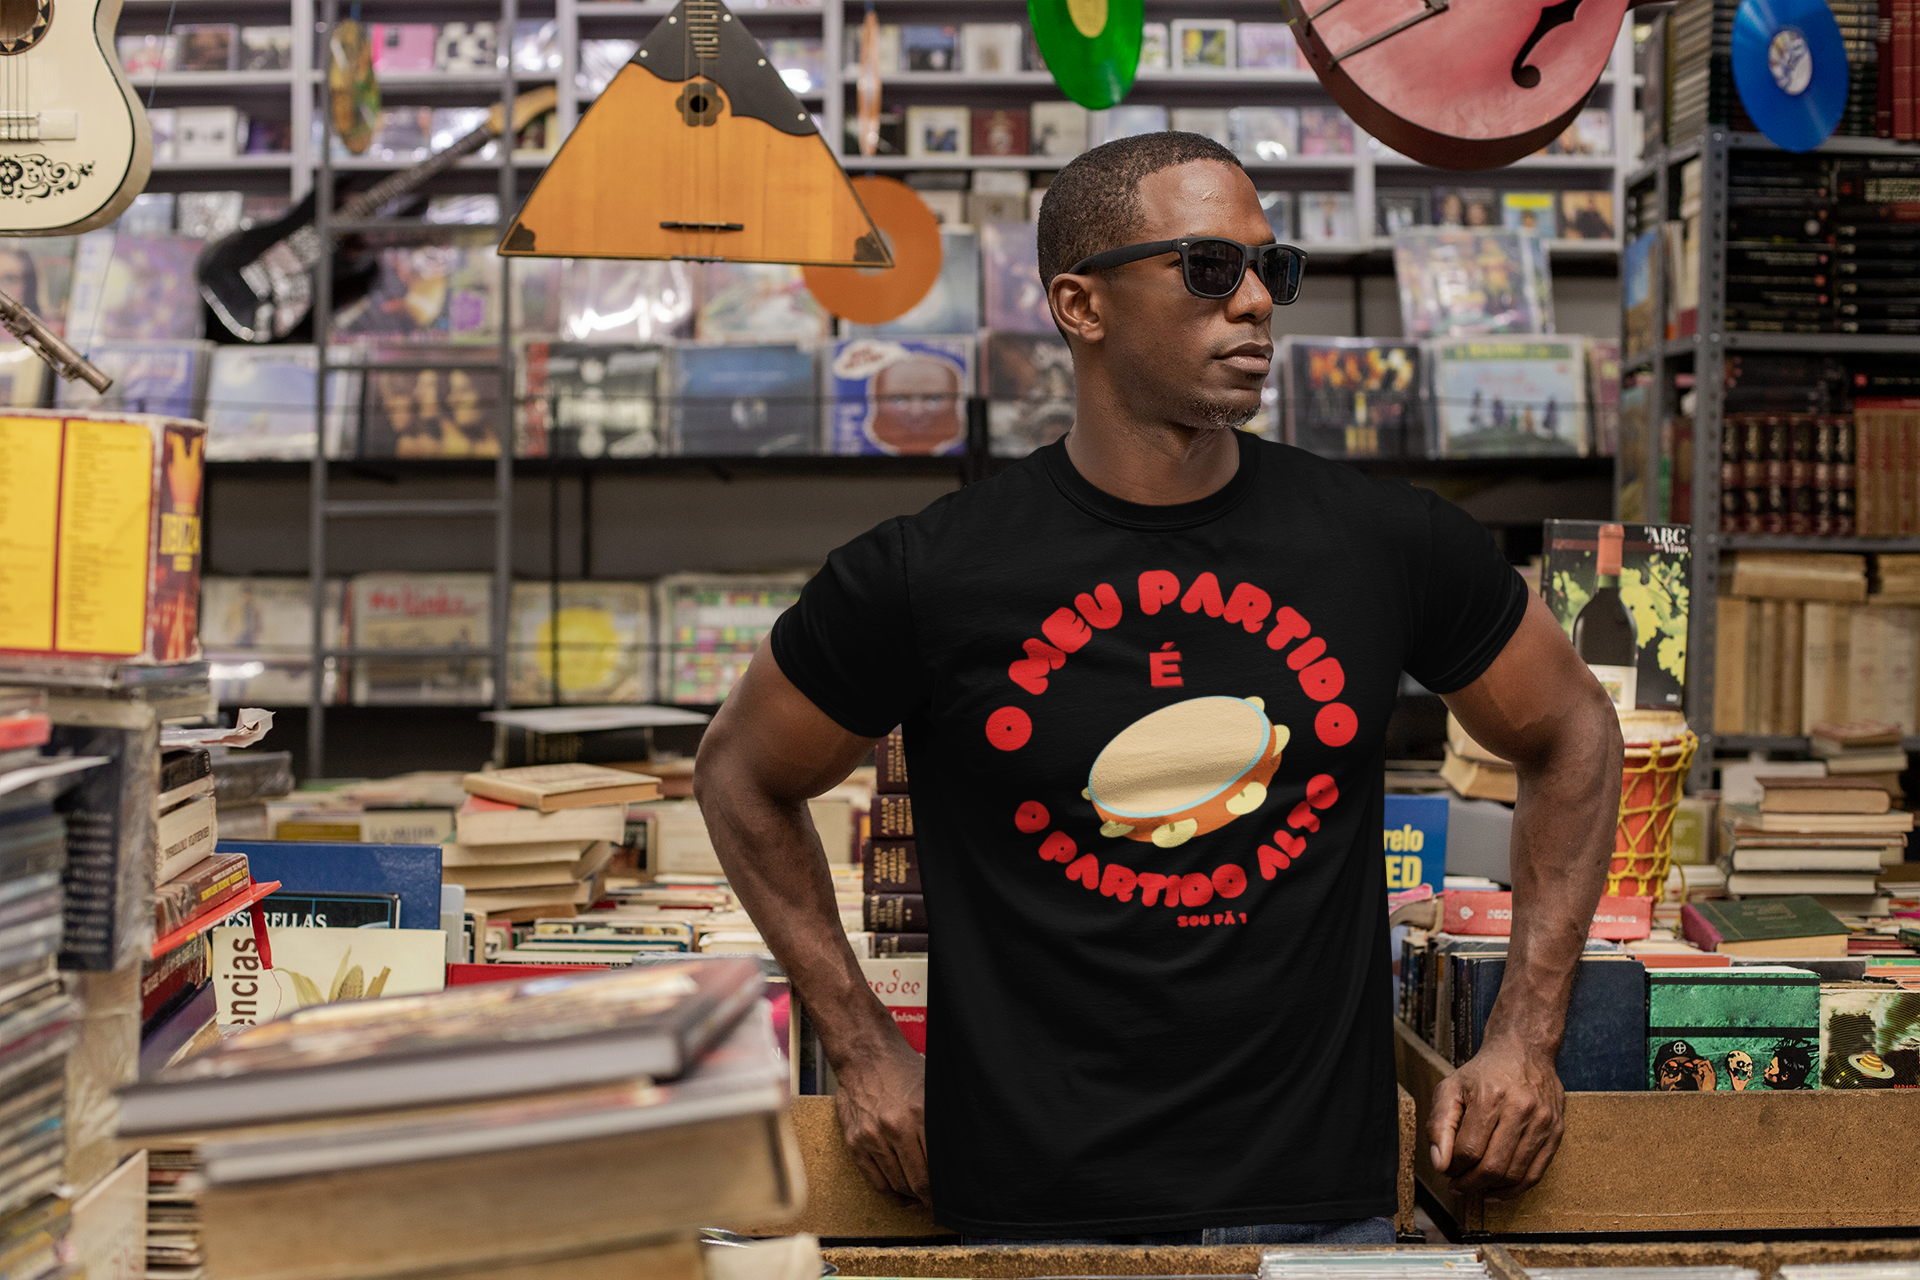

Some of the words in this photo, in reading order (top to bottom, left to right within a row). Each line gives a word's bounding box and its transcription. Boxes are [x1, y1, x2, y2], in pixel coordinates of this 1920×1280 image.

[1648, 527, 1685, 545] ABC
[1008, 582, 1123, 695] MEU
[1138, 569, 1358, 747] PARTIDO
[1149, 641, 1184, 688] É
[985, 705, 1033, 751] O
[1014, 800, 1050, 834] O
[1038, 830, 1247, 908] PARTIDO
[1257, 773, 1339, 880] ALTO
[1177, 914, 1210, 927] SOU
[1213, 910, 1236, 925] FÃ
[1486, 908, 1512, 920] INSO
[892, 1010, 925, 1023] Antonio
